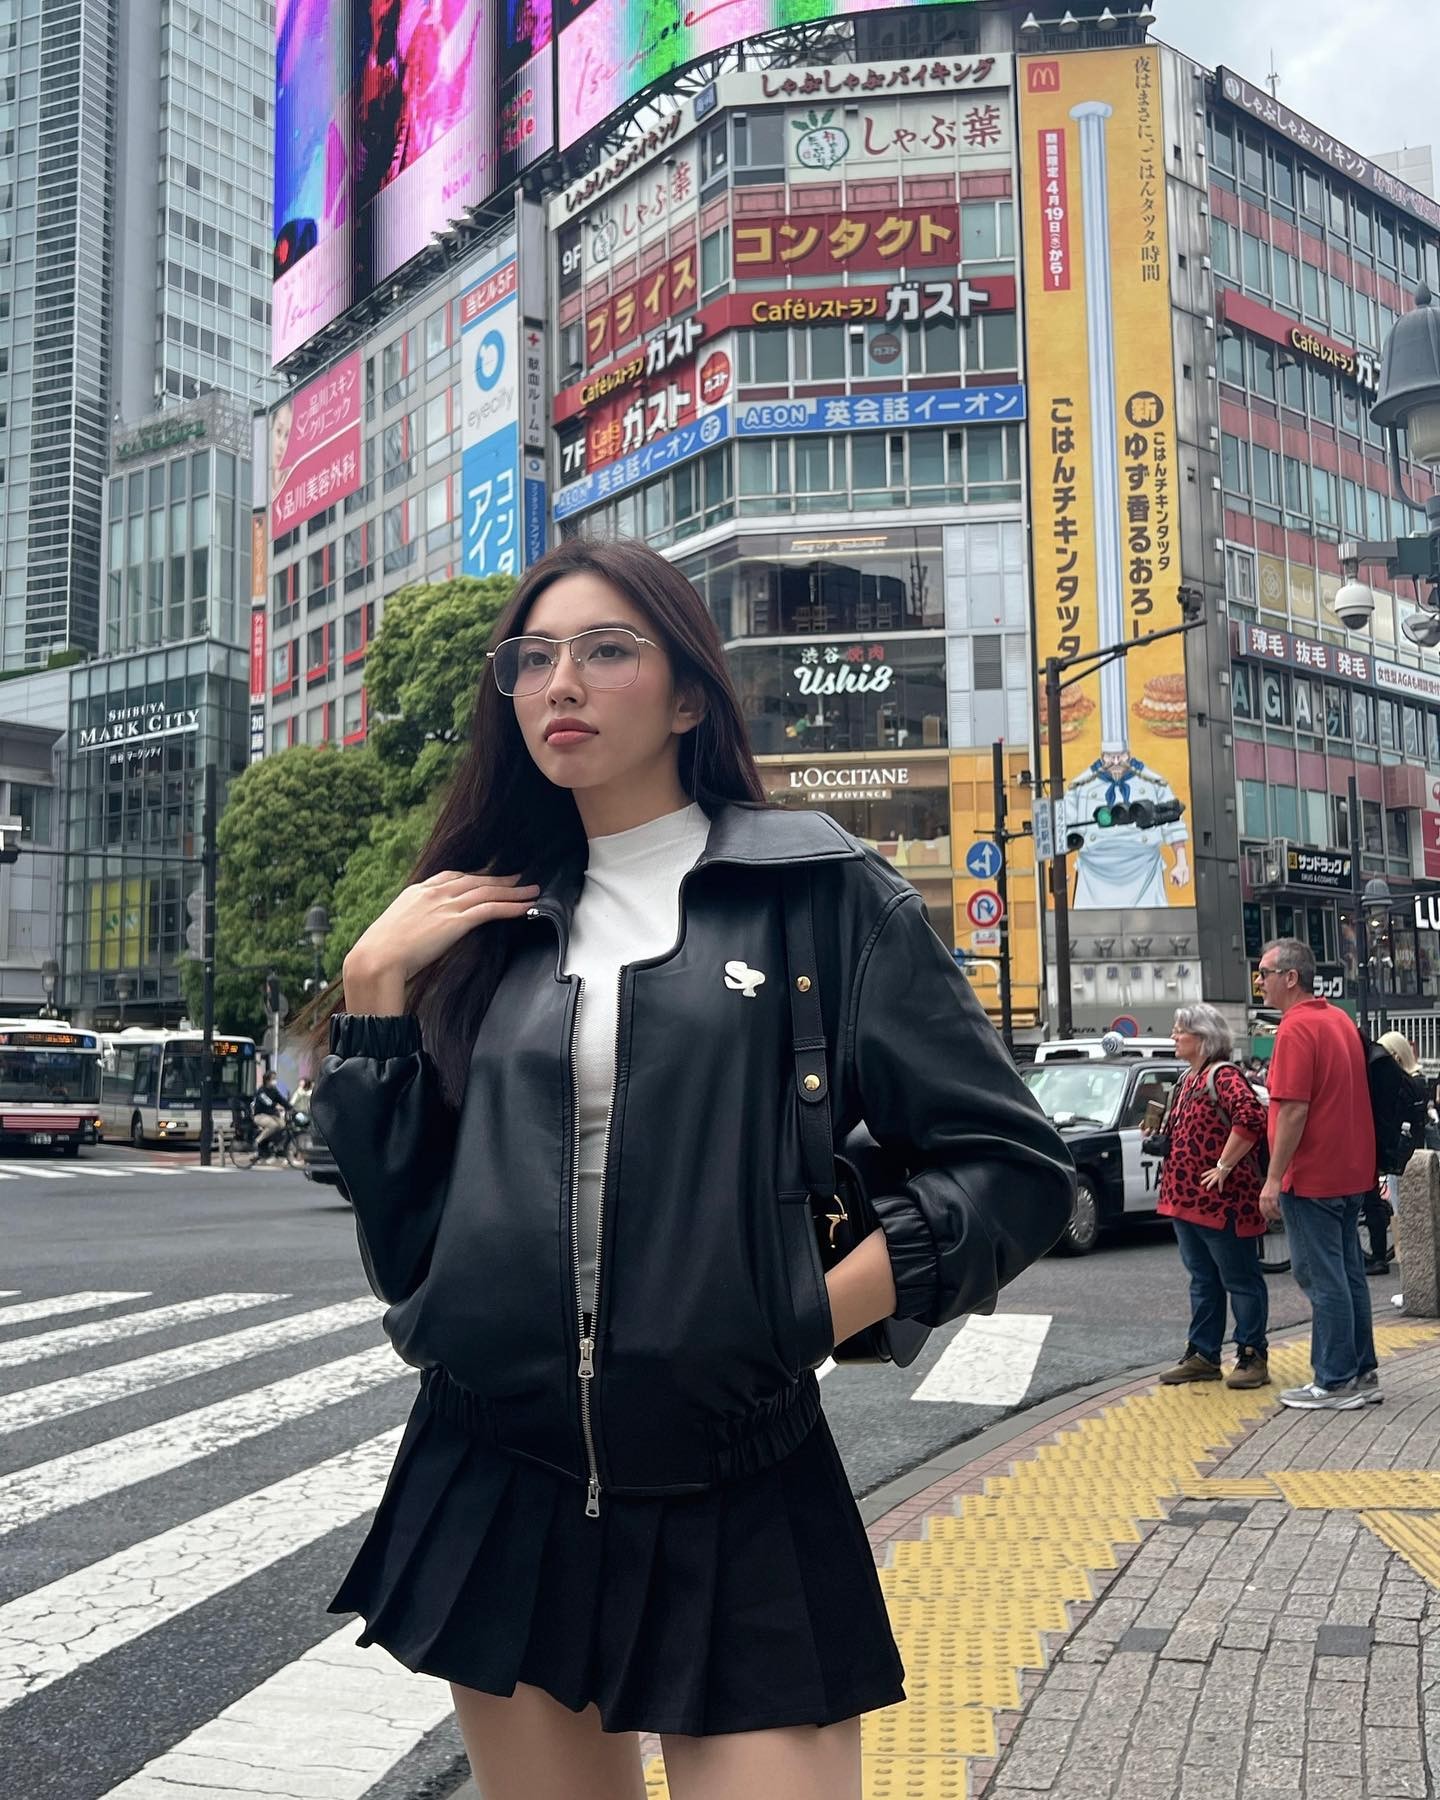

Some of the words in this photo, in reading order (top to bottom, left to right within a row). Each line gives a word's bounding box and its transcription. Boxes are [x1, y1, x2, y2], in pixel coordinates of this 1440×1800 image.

[762, 58, 996, 98] しゃぶしゃぶバイキング
[864, 104, 1001, 156] しゃぶ葉
[1240, 82, 1369, 178] しゃぶしゃぶバイキング
[566, 110, 682, 212] しゃぶしゃぶバイキング
[1135, 56, 1160, 281] 夜はまさに、ごはんタツタ時間
[623, 161, 690, 236] しゃぶ葉
[562, 245, 581, 275] 9F
[735, 215, 951, 264] コンタクト
[465, 266, 515, 318] 当ビル5F
[587, 255, 697, 353] プライス
[752, 297, 877, 324] Caféレストラン
[886, 281, 989, 322] ガスト
[646, 317, 703, 376] ガスト
[309, 369, 356, 416] 品川スキン
[527, 358, 541, 430] 献血ルーム
[703, 373, 728, 394] ガスト
[744, 406, 806, 426] AEON
[824, 392, 1018, 426] 英会話イーオン
[309, 399, 351, 441] クリニック
[622, 384, 691, 454] ガスト
[1130, 397, 1157, 423] 新
[563, 438, 586, 474] 7F
[598, 431, 696, 497] 英会話イーオン
[284, 454, 357, 521] 品川美容外科
[1153, 431, 1170, 571] ごはんチキンタツタ
[467, 480, 493, 577] アイ
[1051, 397, 1080, 664] ごはんチキンタツタ
[794, 664, 894, 696] Ushi8
[1251, 628, 1285, 658] 薄毛
[1295, 640, 1327, 669] 抜毛
[1337, 652, 1367, 680] 発毛
[108, 701, 165, 722] SHIBUYA
[1232, 671, 1312, 725] AGA
[80, 720, 139, 746] MARK
[148, 708, 200, 732] CITY
[790, 768, 909, 788] L'OCCITANE
[830, 790, 887, 800] PROVENCE
